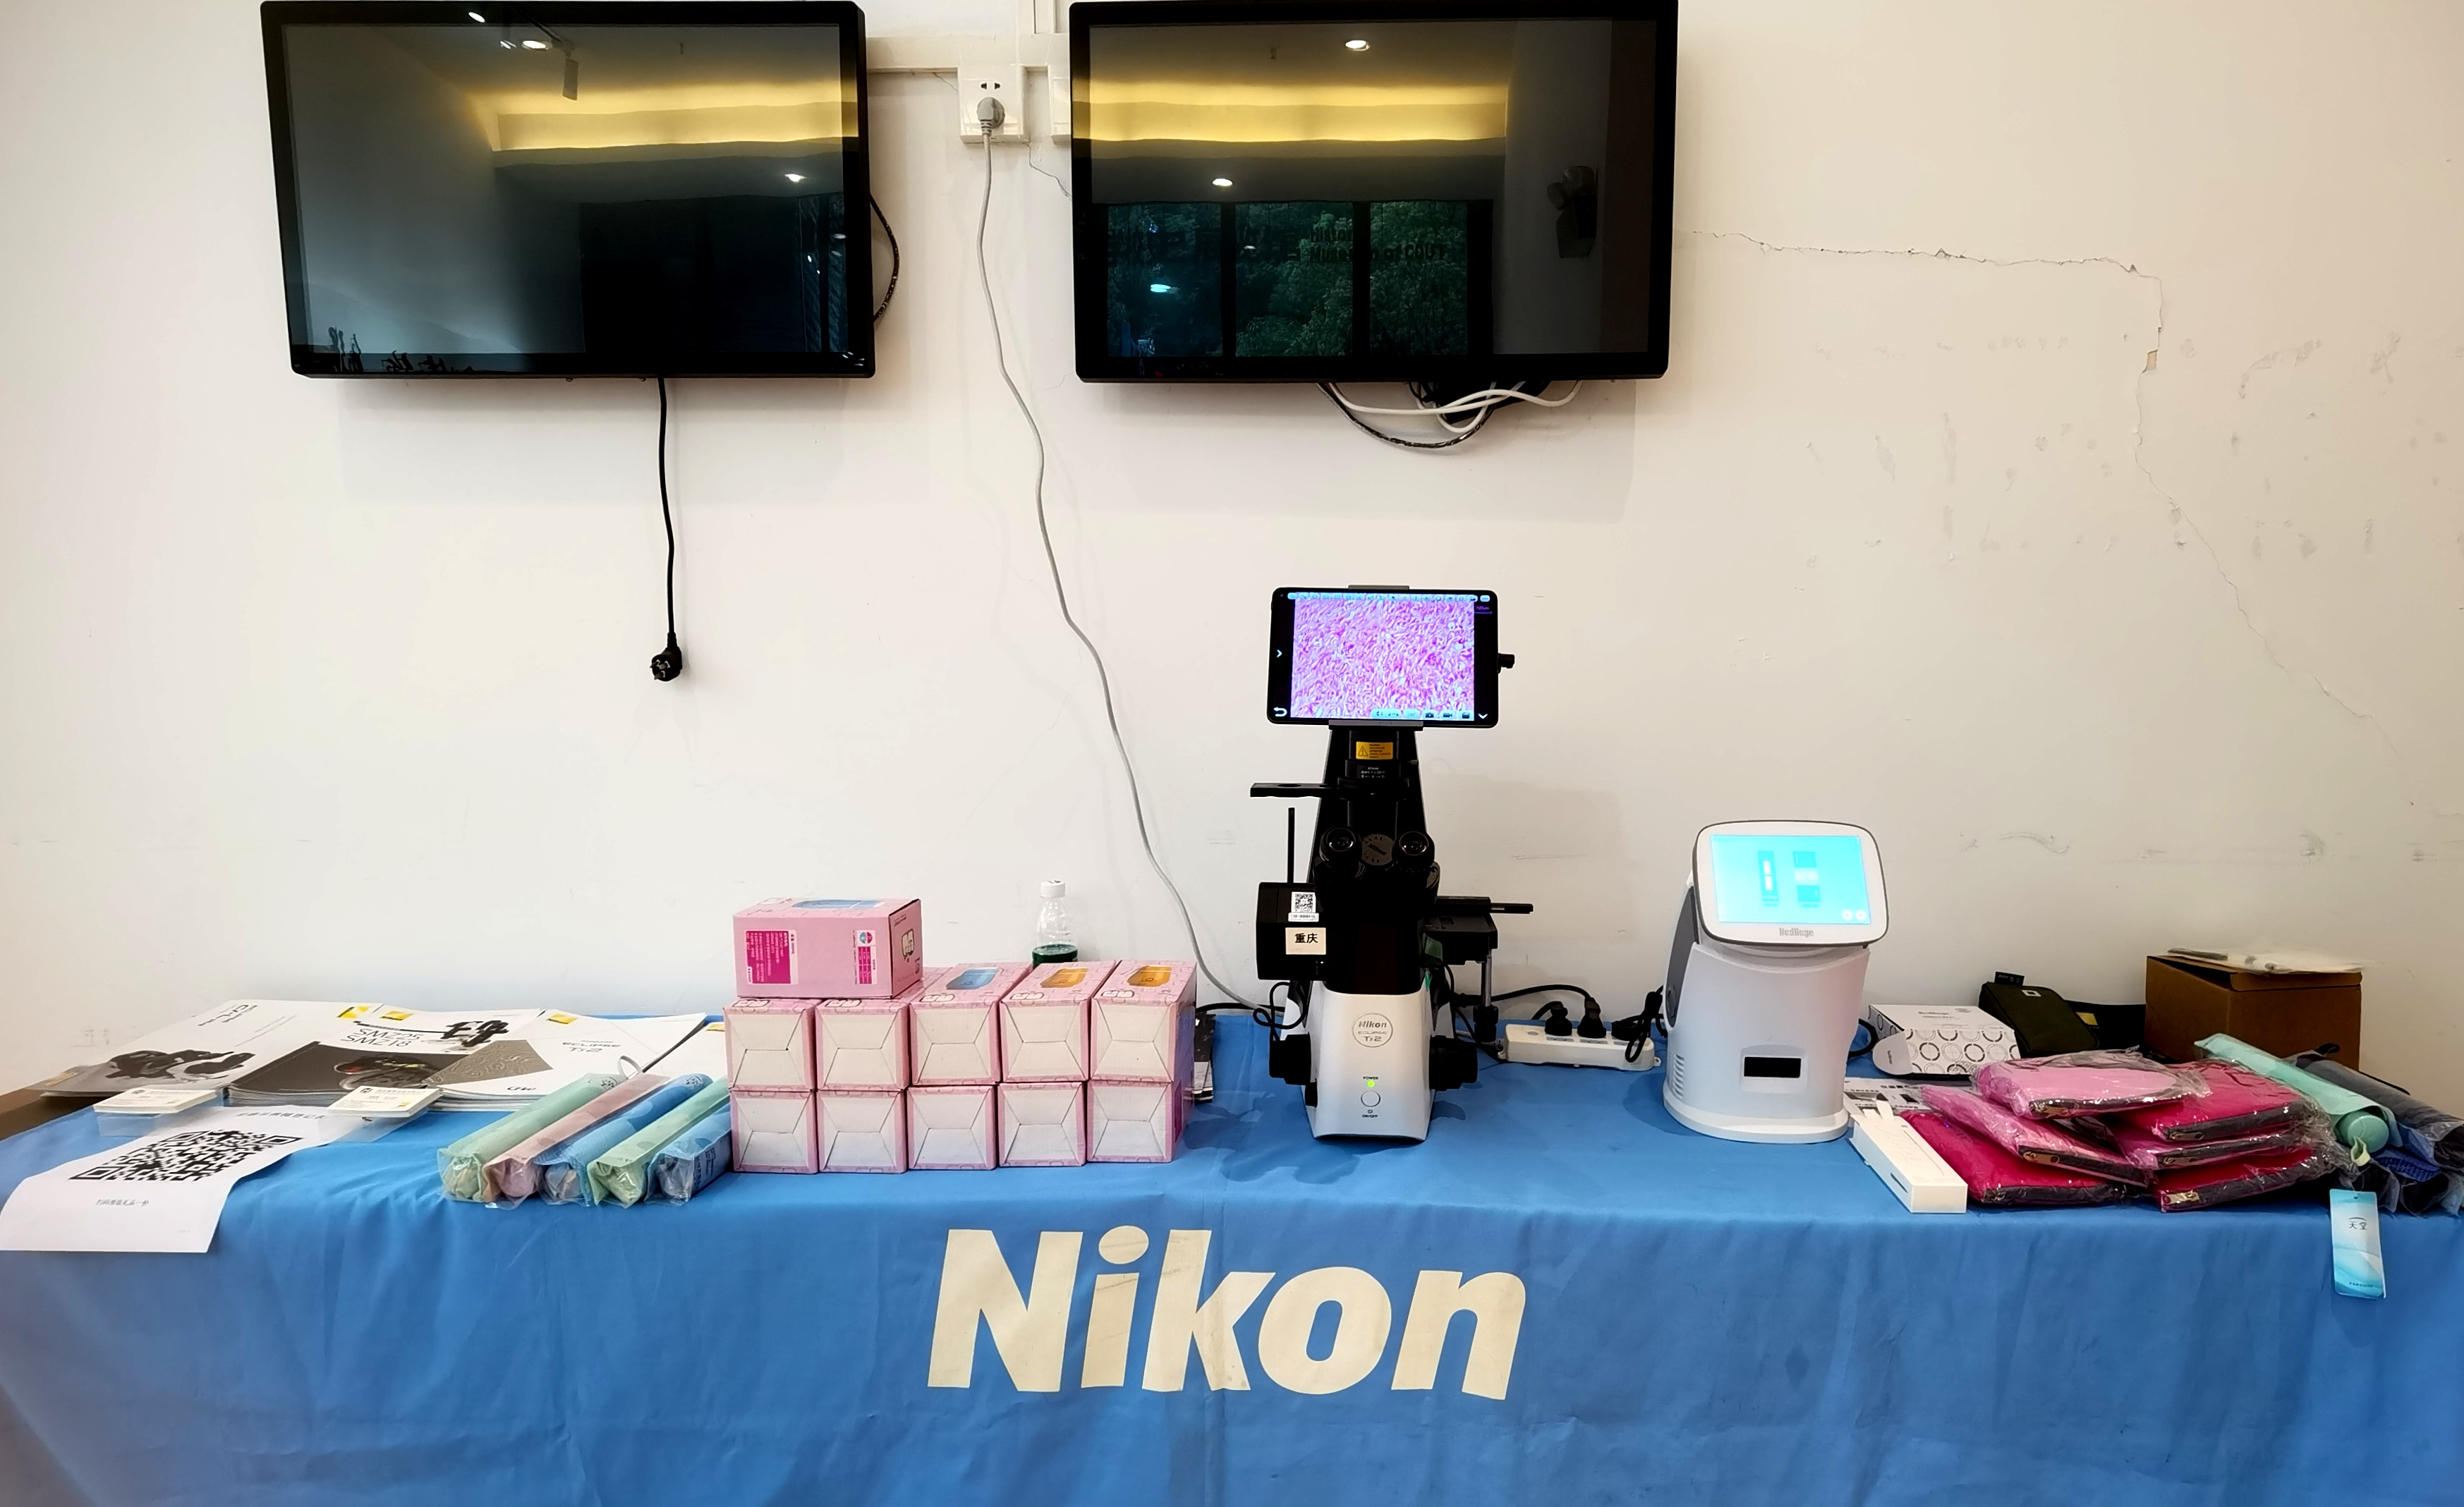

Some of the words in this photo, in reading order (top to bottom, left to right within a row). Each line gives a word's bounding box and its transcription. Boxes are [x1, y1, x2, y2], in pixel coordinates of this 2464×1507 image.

[1311, 226, 1354, 243] Histor
[1367, 843, 1387, 855] Nikon
[1294, 932, 1318, 944] 重庆
[353, 1028, 423, 1040] SMZ25
[341, 1035, 412, 1047] SMZ18
[928, 1225, 1527, 1401] Nikon
